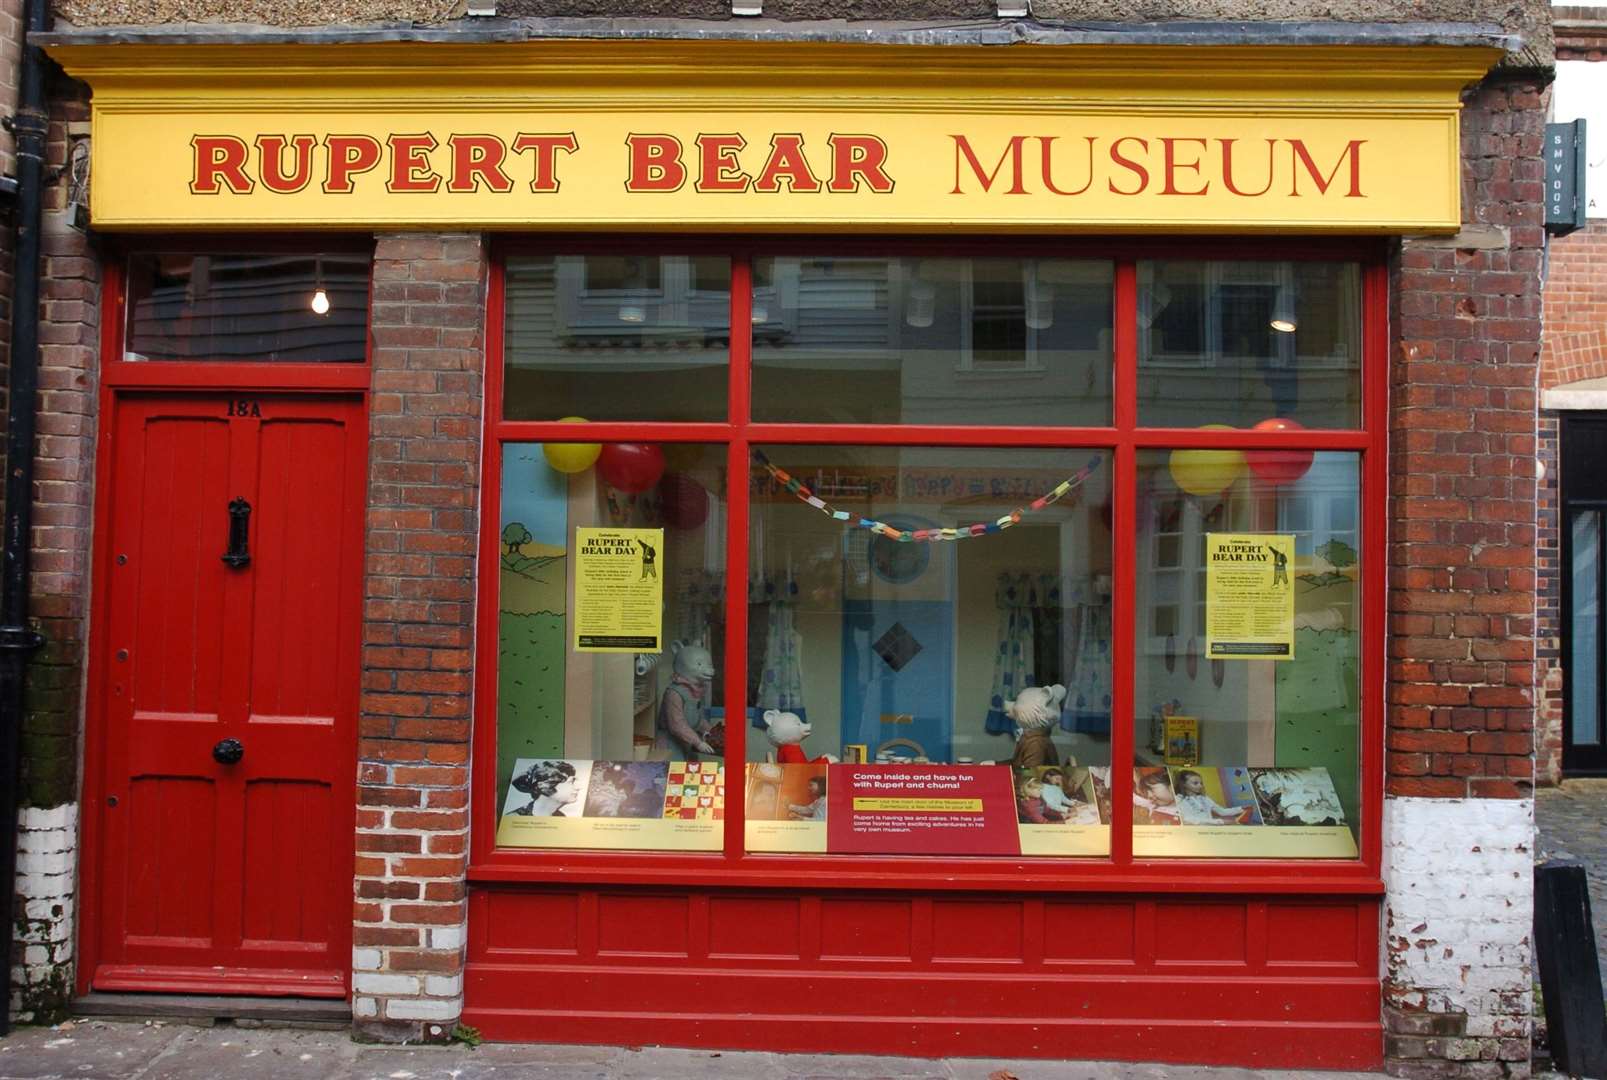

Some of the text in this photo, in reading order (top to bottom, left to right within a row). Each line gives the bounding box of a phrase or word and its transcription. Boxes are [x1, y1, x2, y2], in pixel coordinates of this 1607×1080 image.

[188, 131, 1369, 197] RUPERT BEAR MUSEUM
[227, 399, 261, 417] 18A
[587, 538, 633, 547] RUPERT
[581, 546, 638, 555] BEAR DAY
[1218, 544, 1264, 553] RUPERT
[1212, 553, 1243, 561] BEAR
[884, 773, 911, 781] inside
[874, 781, 904, 789] Rupert
